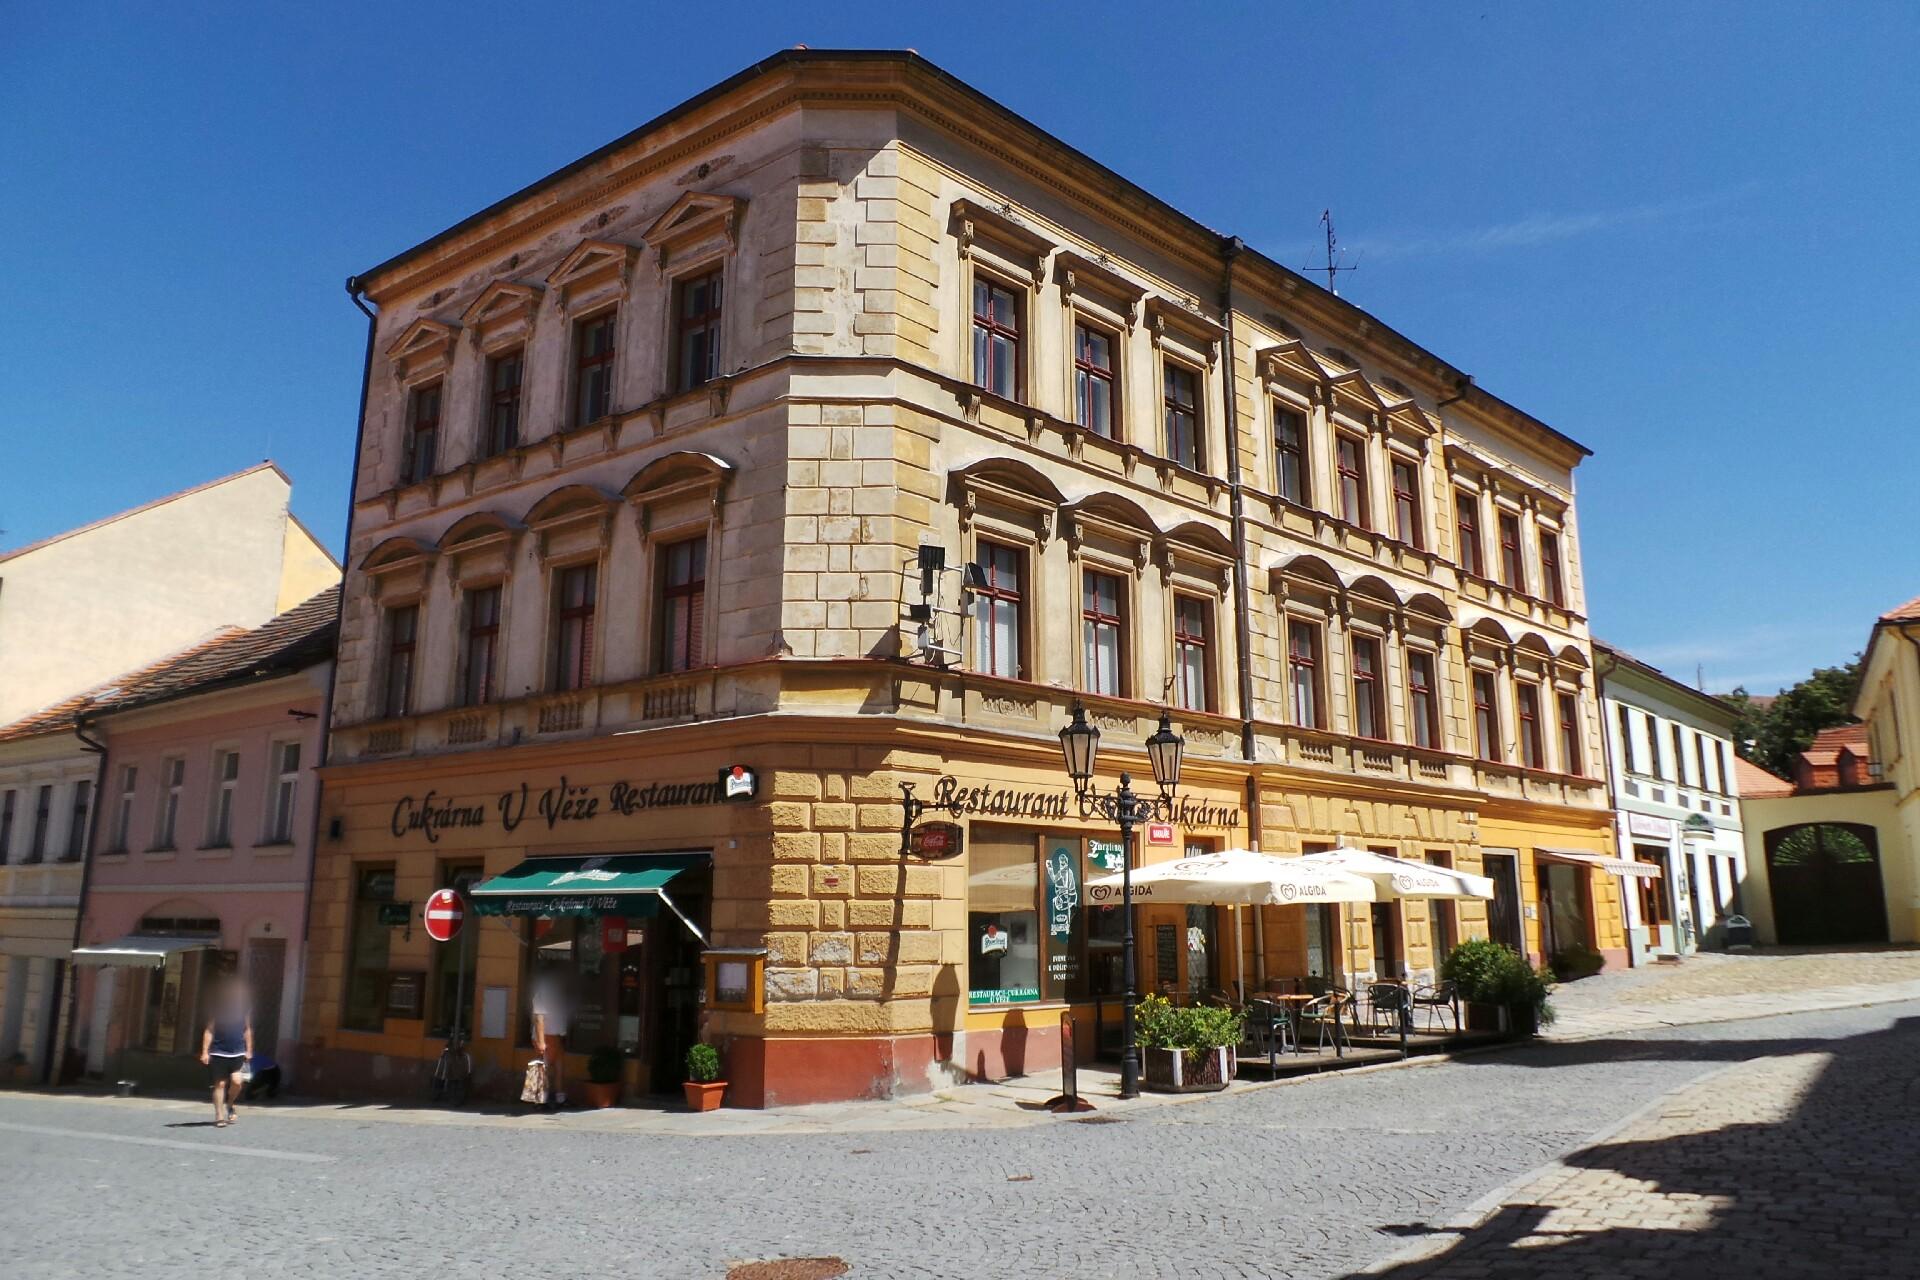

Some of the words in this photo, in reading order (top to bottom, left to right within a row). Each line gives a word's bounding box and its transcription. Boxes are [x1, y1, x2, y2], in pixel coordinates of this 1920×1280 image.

[391, 790, 485, 843] Cukrárna
[498, 782, 528, 832] U
[539, 775, 598, 830] Věže
[609, 780, 725, 816] Restauran
[934, 775, 1069, 820] Restaurant
[1114, 885, 1152, 897] AGIDA
[1299, 886, 1327, 897] ALGIDA
